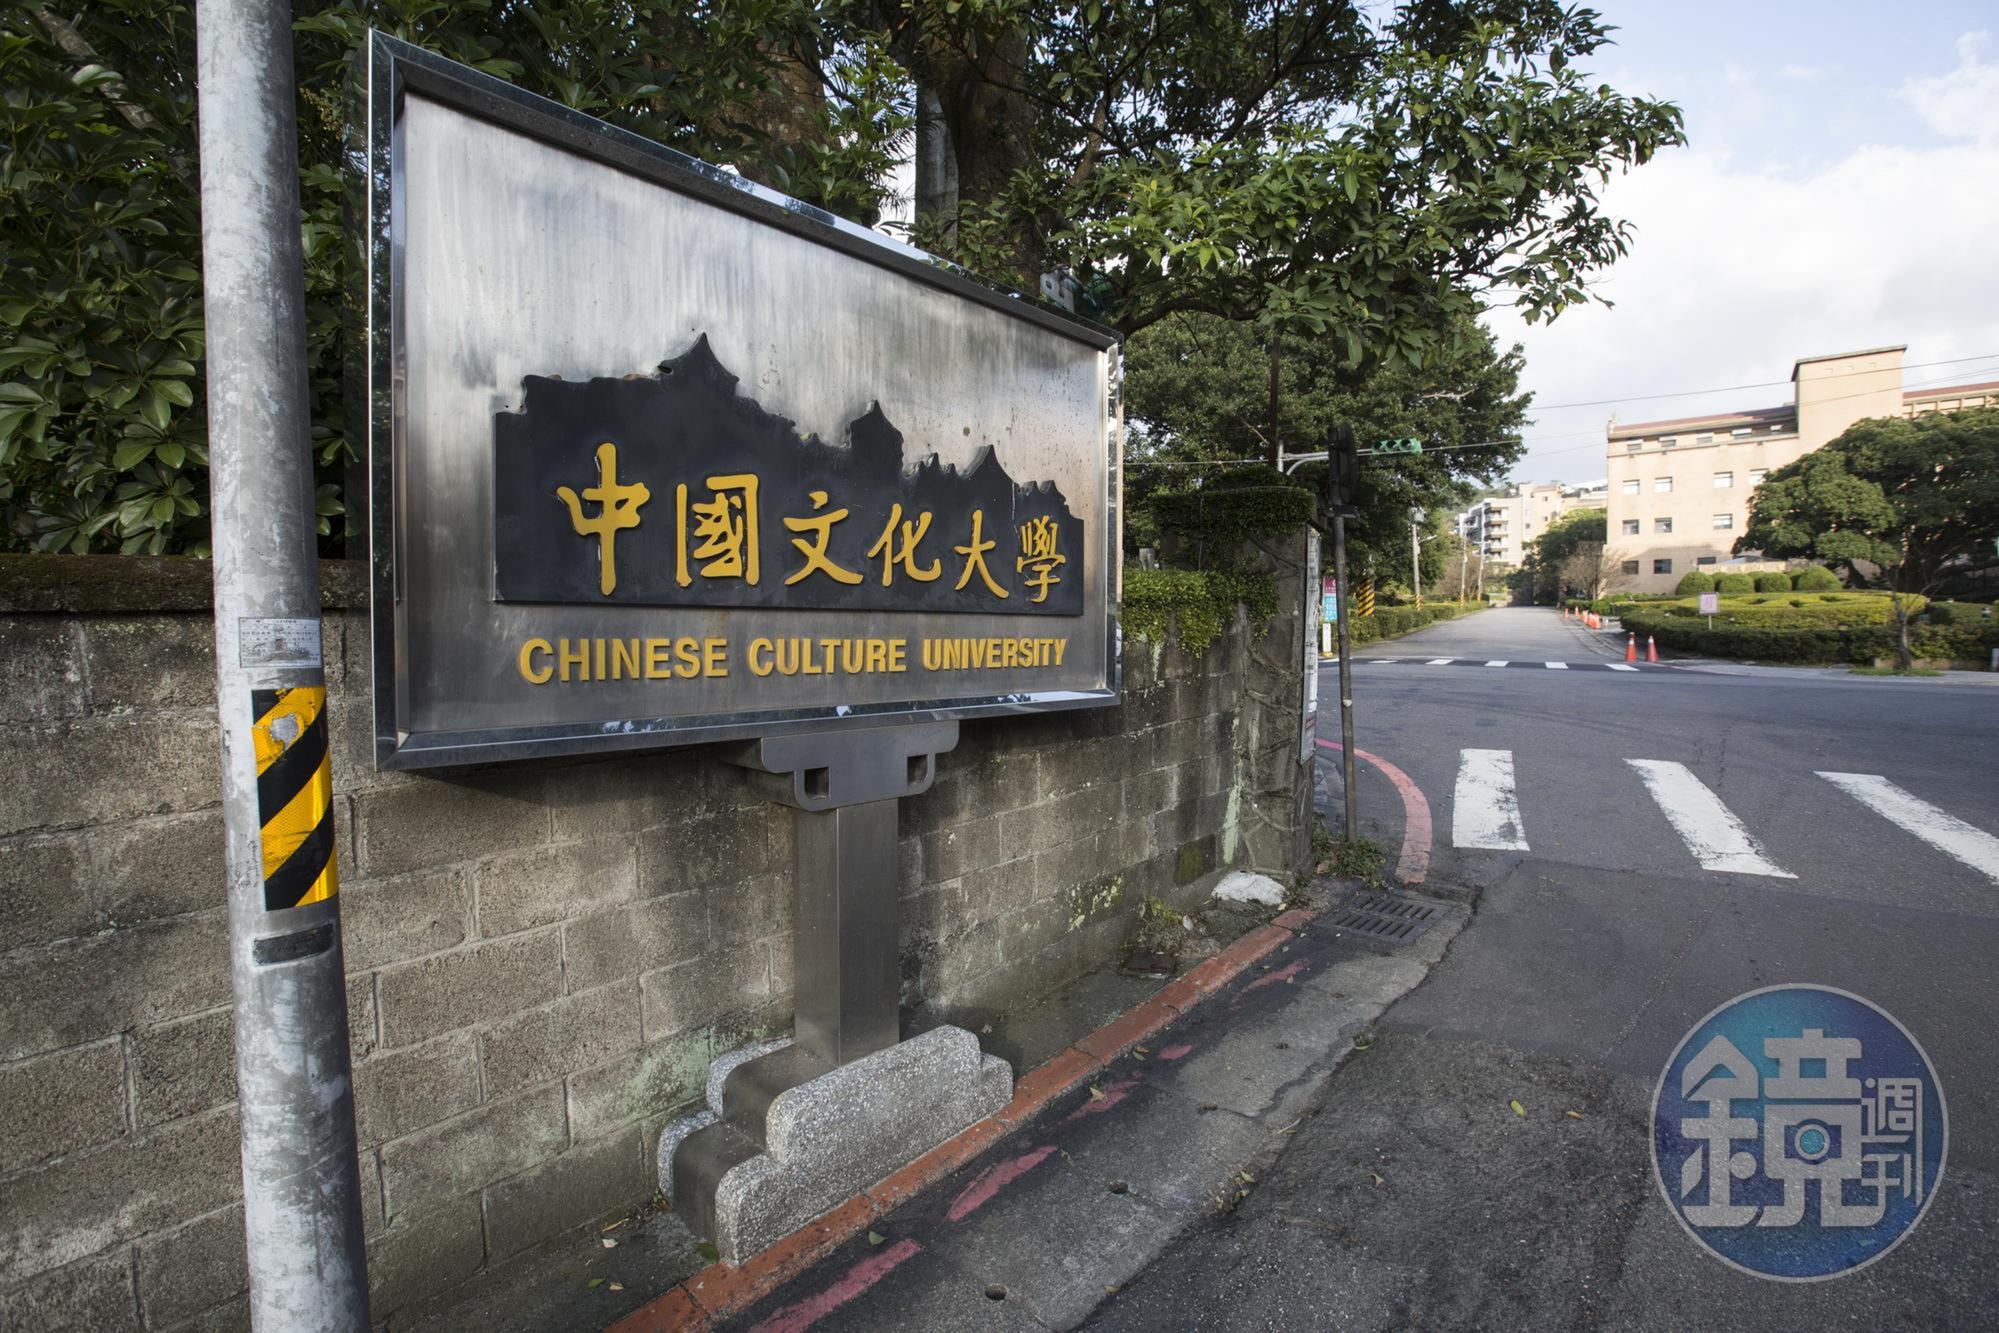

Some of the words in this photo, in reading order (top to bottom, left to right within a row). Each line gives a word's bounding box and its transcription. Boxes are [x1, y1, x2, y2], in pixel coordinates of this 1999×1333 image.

[556, 442, 1066, 603] 中國文化大學
[518, 637, 728, 685] CHINESE
[748, 637, 907, 677] CULTURE
[922, 637, 1067, 671] UNIVERSITY
